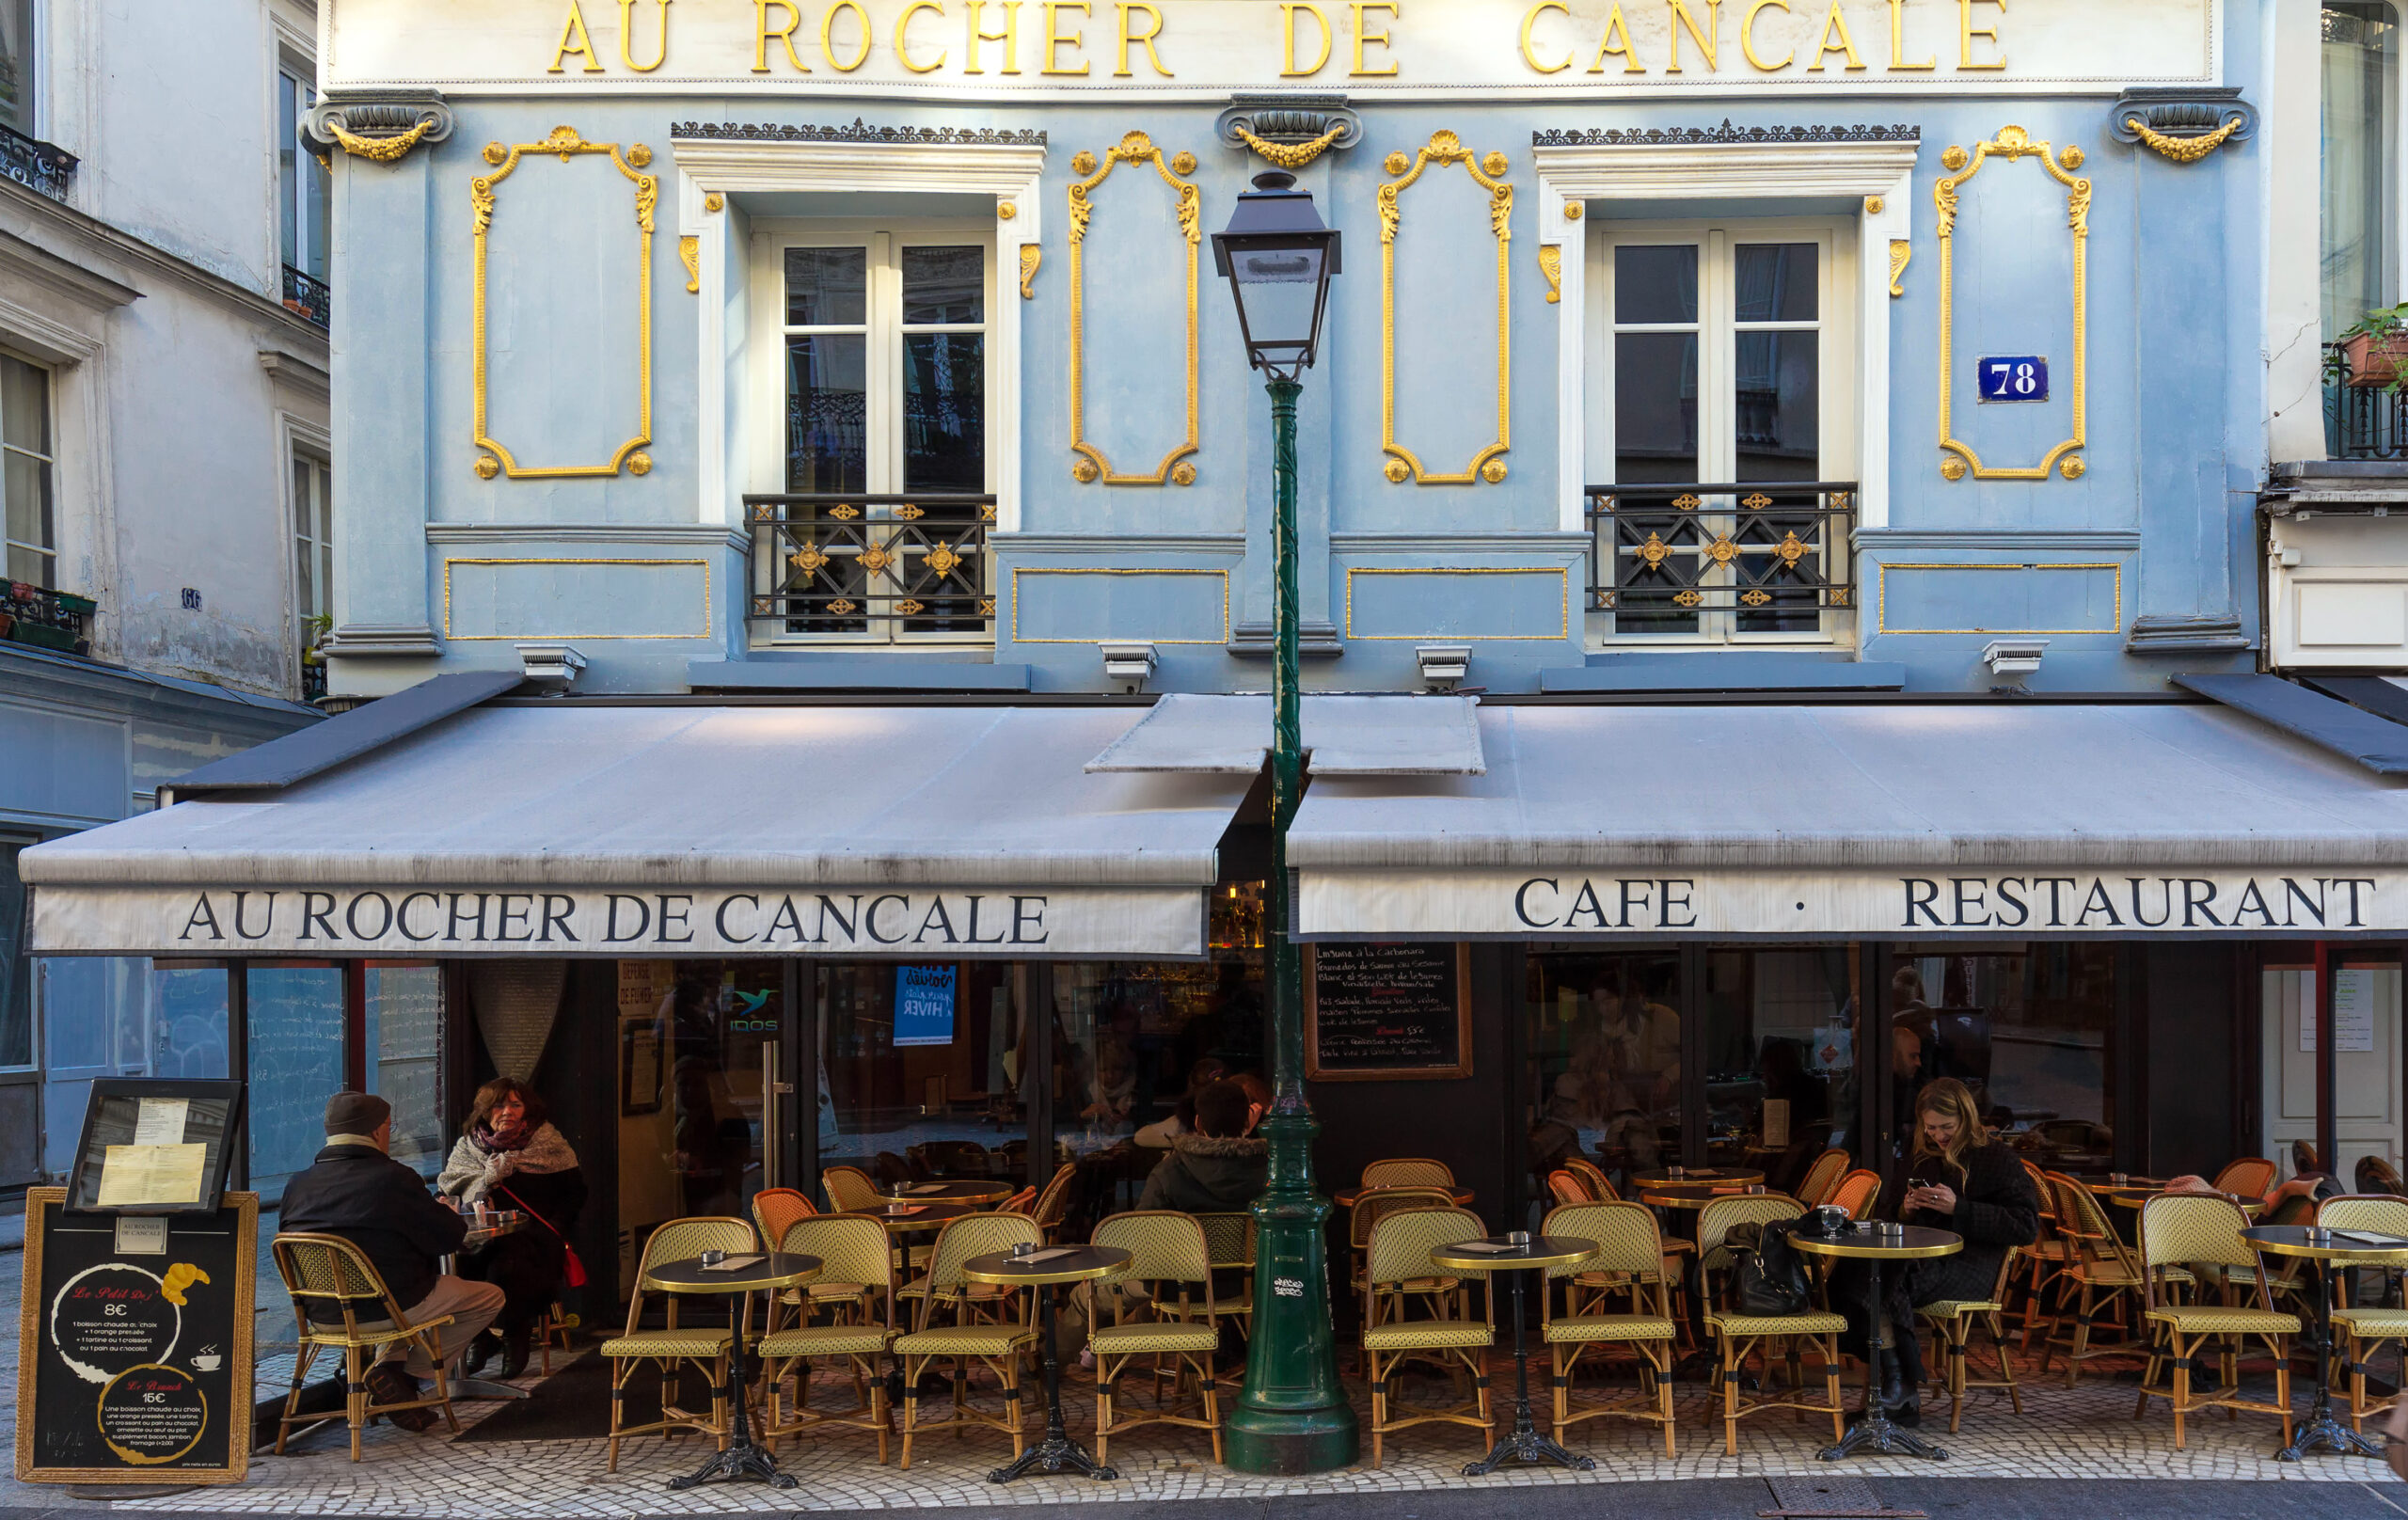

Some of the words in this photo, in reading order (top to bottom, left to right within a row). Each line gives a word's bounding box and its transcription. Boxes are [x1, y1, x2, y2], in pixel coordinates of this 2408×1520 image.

[547, 0, 671, 73] AU
[751, 0, 1174, 77] ROCHER
[1279, 3, 1399, 77] DE
[1519, 0, 2007, 75] CANCALE
[1991, 363, 2036, 395] 78
[183, 588, 201, 610] 66
[1515, 878, 1697, 927] CAFE
[1899, 877, 2376, 927] RESTAURANT
[178, 891, 280, 940] AU
[296, 891, 580, 942] ROCHER
[602, 894, 693, 942] DE
[716, 894, 1049, 943] CANCALE
[620, 989, 629, 1005] DE
[730, 1020, 778, 1033] IQOS
[72, 1287, 91, 1299] Le
[104, 1304, 127, 1316] 8€
[142, 1392, 166, 1403] 15€
